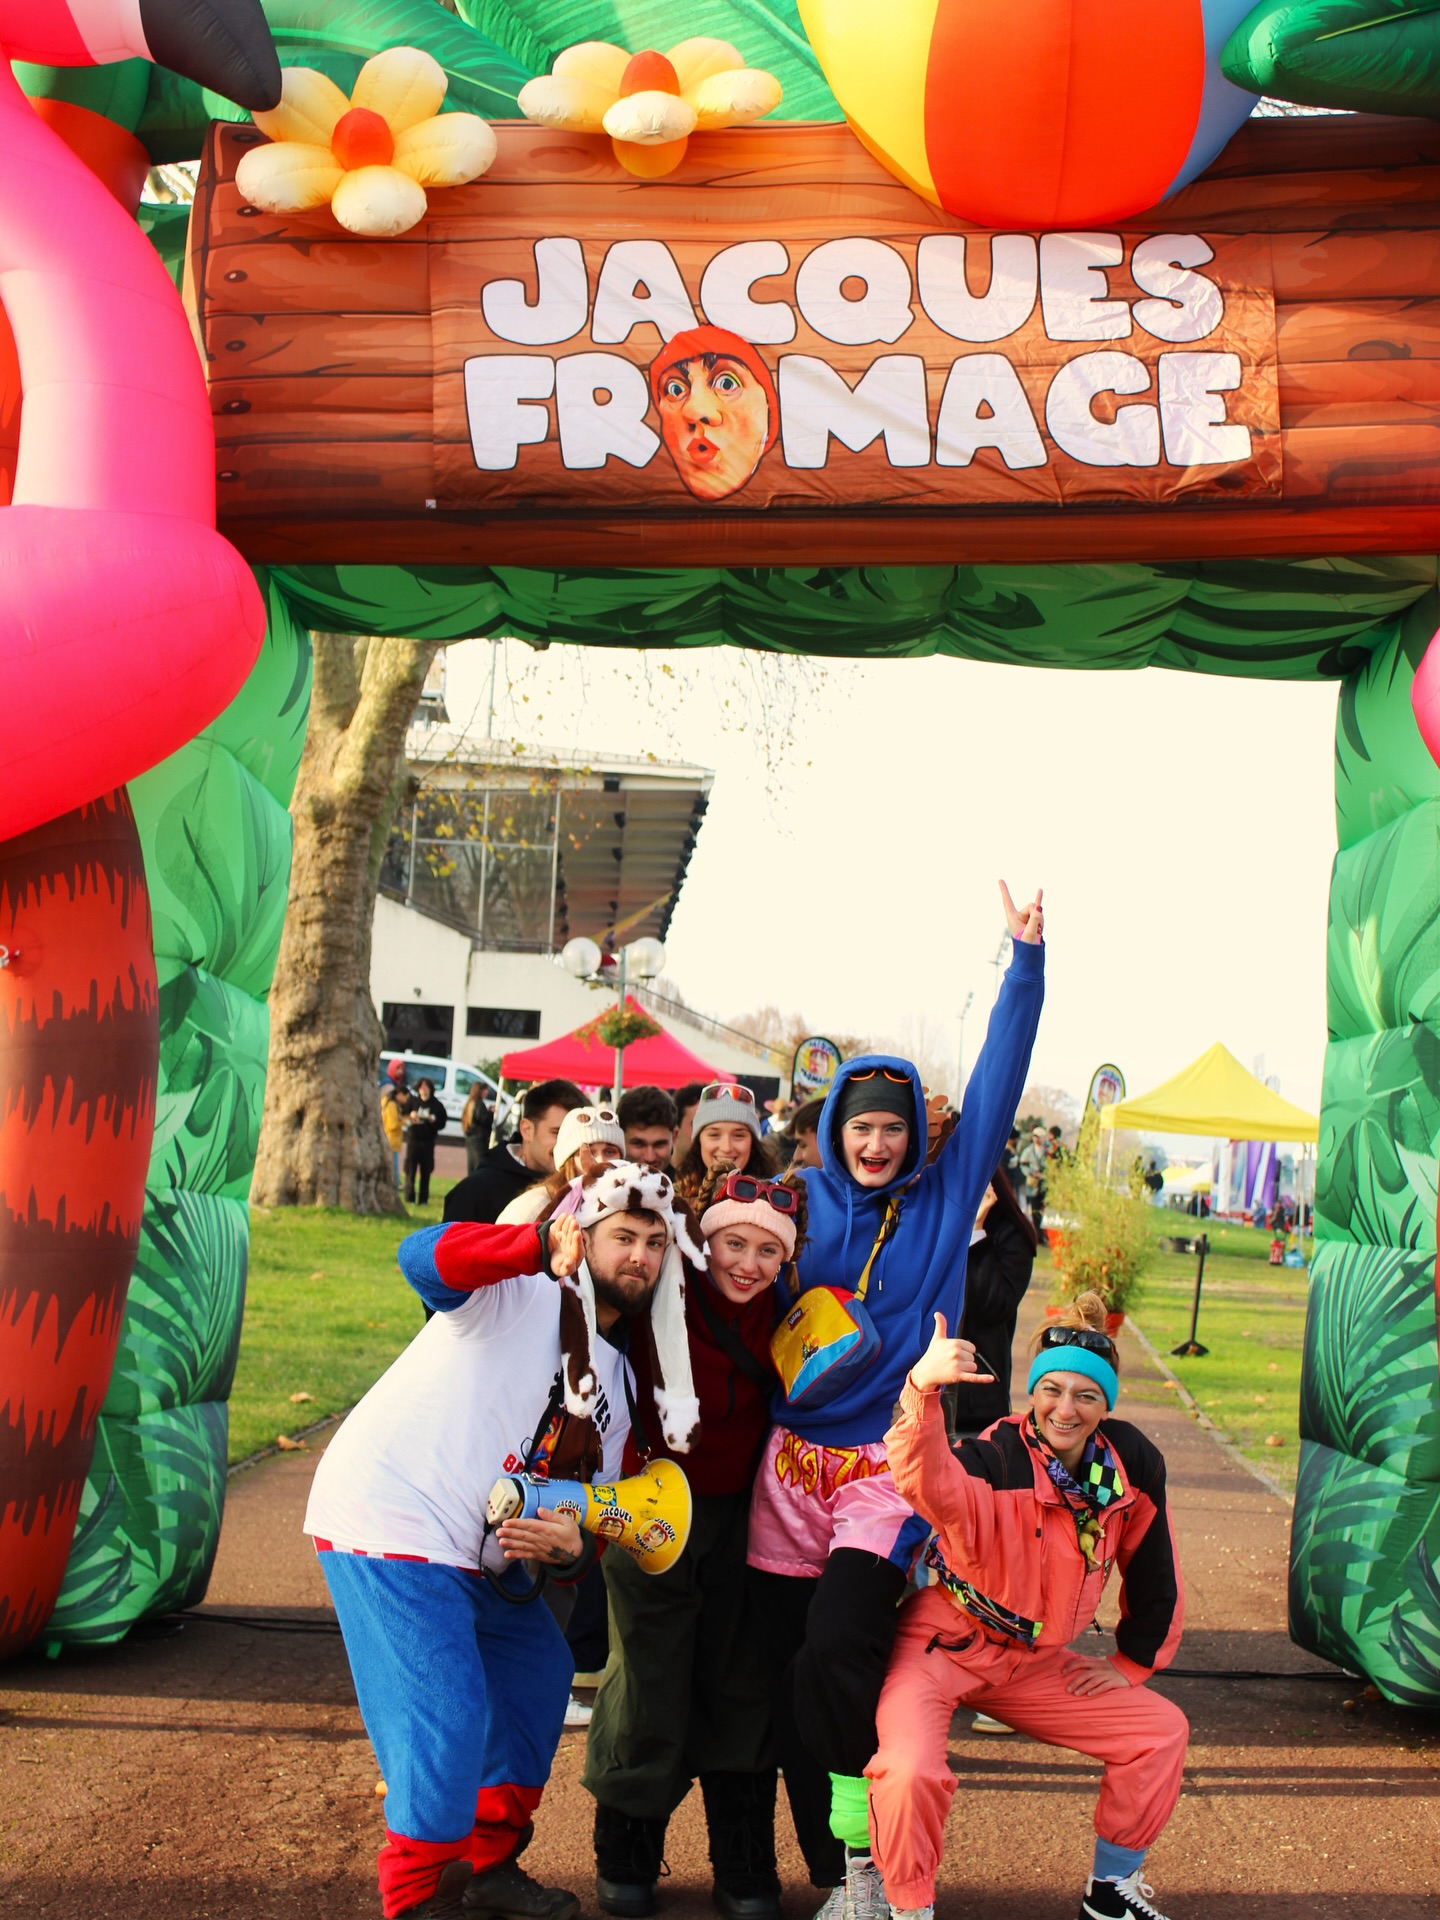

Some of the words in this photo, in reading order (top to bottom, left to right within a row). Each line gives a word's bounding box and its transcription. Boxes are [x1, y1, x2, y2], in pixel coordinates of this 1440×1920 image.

[480, 232, 1224, 345] JACQUES
[463, 352, 1253, 470] FRMAGE
[557, 1499, 582, 1513] JACQUES
[599, 1507, 632, 1523] JACQUES
[654, 1518, 676, 1542] JACQUES
